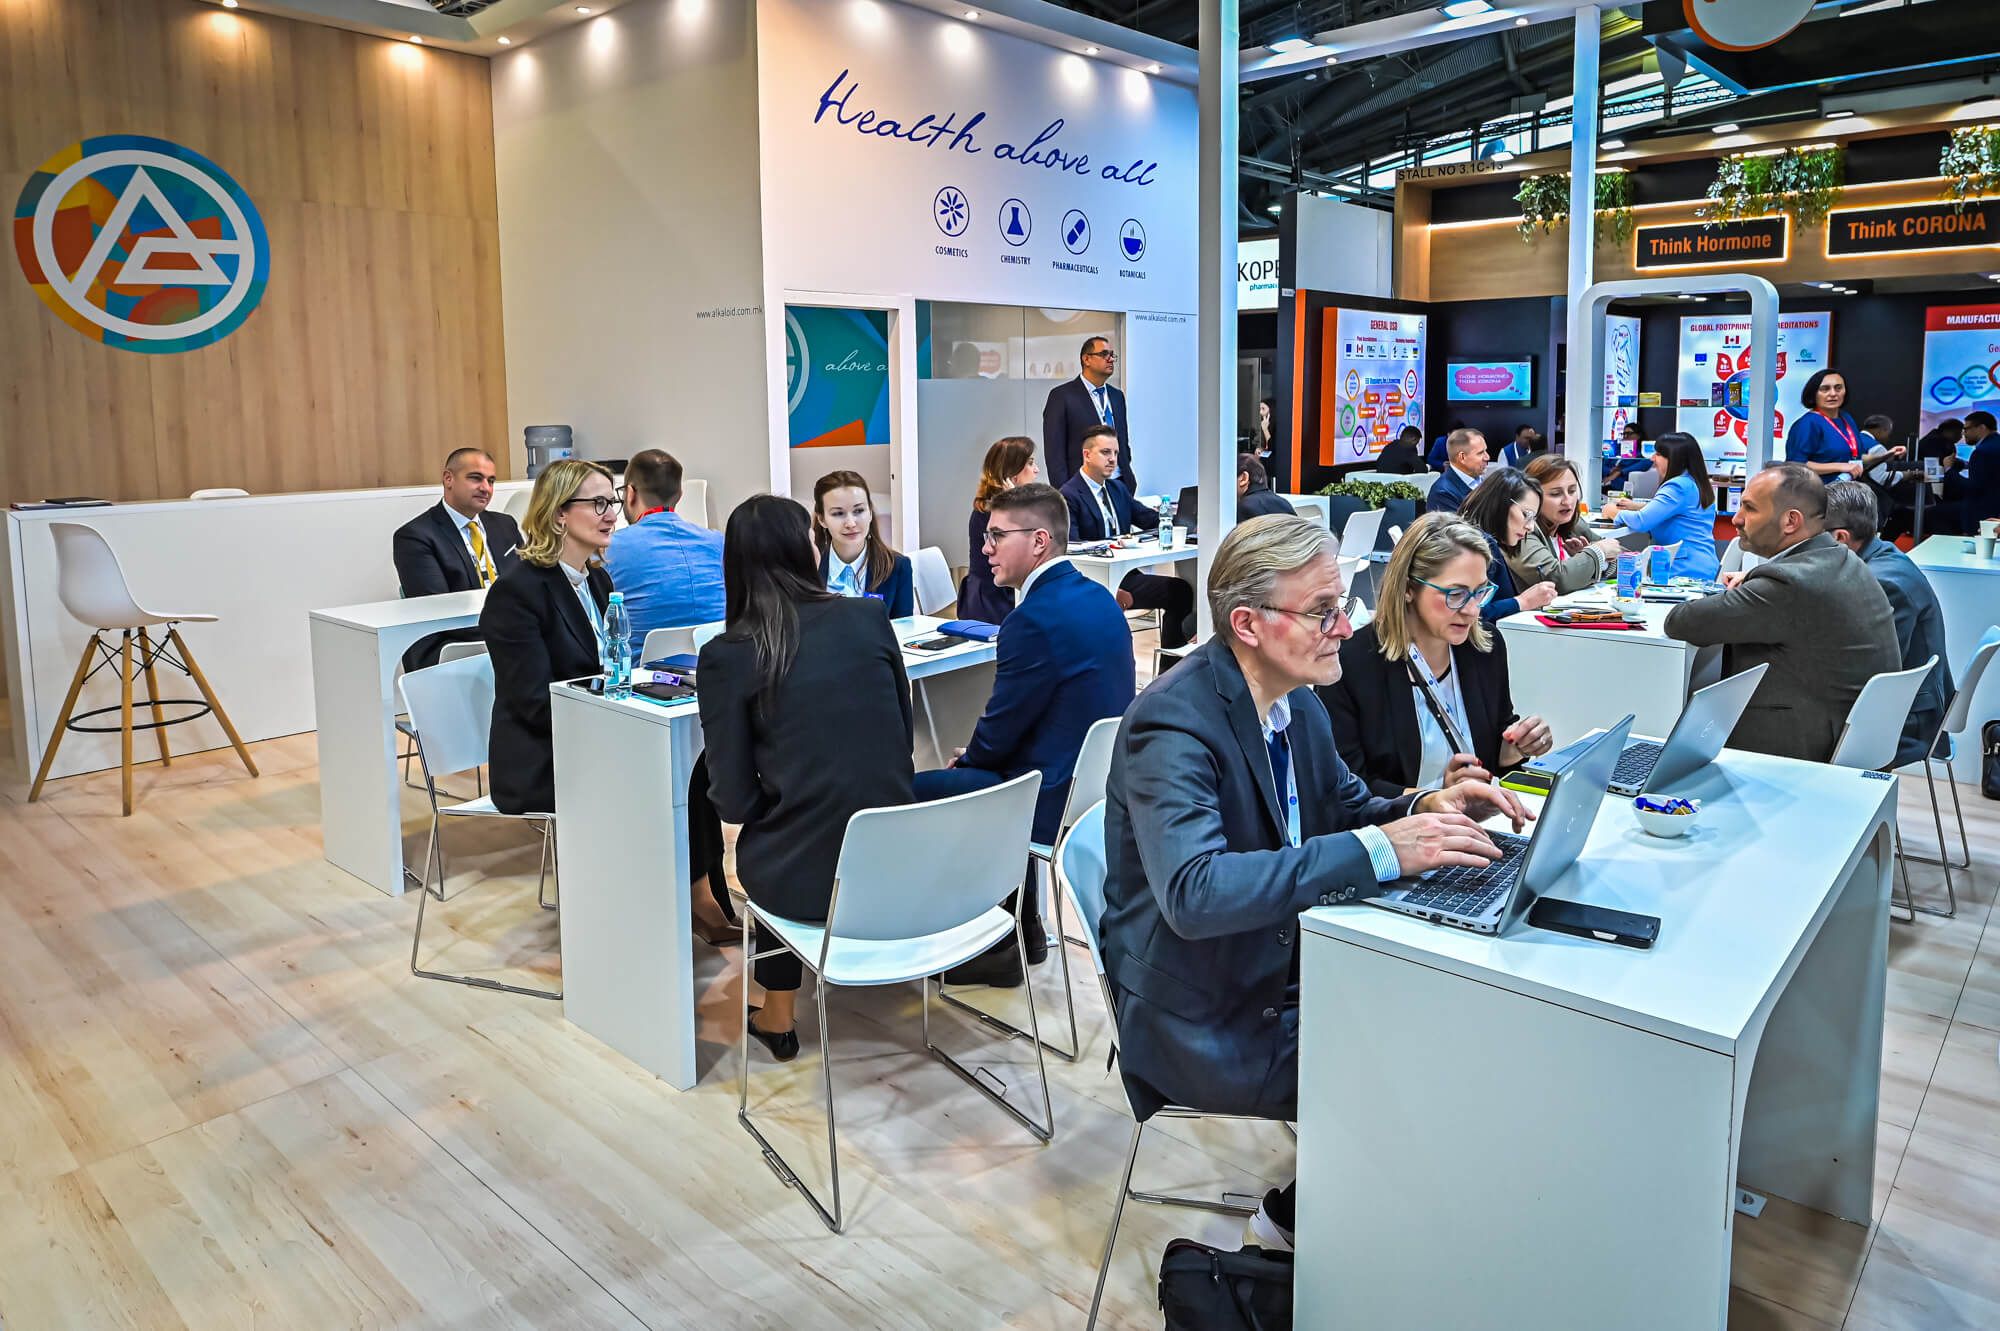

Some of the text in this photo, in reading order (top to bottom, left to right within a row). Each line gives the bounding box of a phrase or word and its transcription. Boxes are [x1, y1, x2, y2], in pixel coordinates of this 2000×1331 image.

[814, 69, 1158, 185] Health above all
[1398, 168, 1434, 180] STALL
[1438, 165, 1456, 176] NO
[1848, 212, 1987, 240] Think CORONA
[1650, 234, 1772, 255] Think Hormone
[935, 246, 969, 258] COSMETICS
[1000, 254, 1031, 265] CHEMISTRY
[1052, 261, 1099, 275] PHARMACEUTICALS
[1119, 269, 1146, 280] BOTANICALS
[1691, 323, 1714, 331] GLOBAL
[825, 349, 872, 371] above
